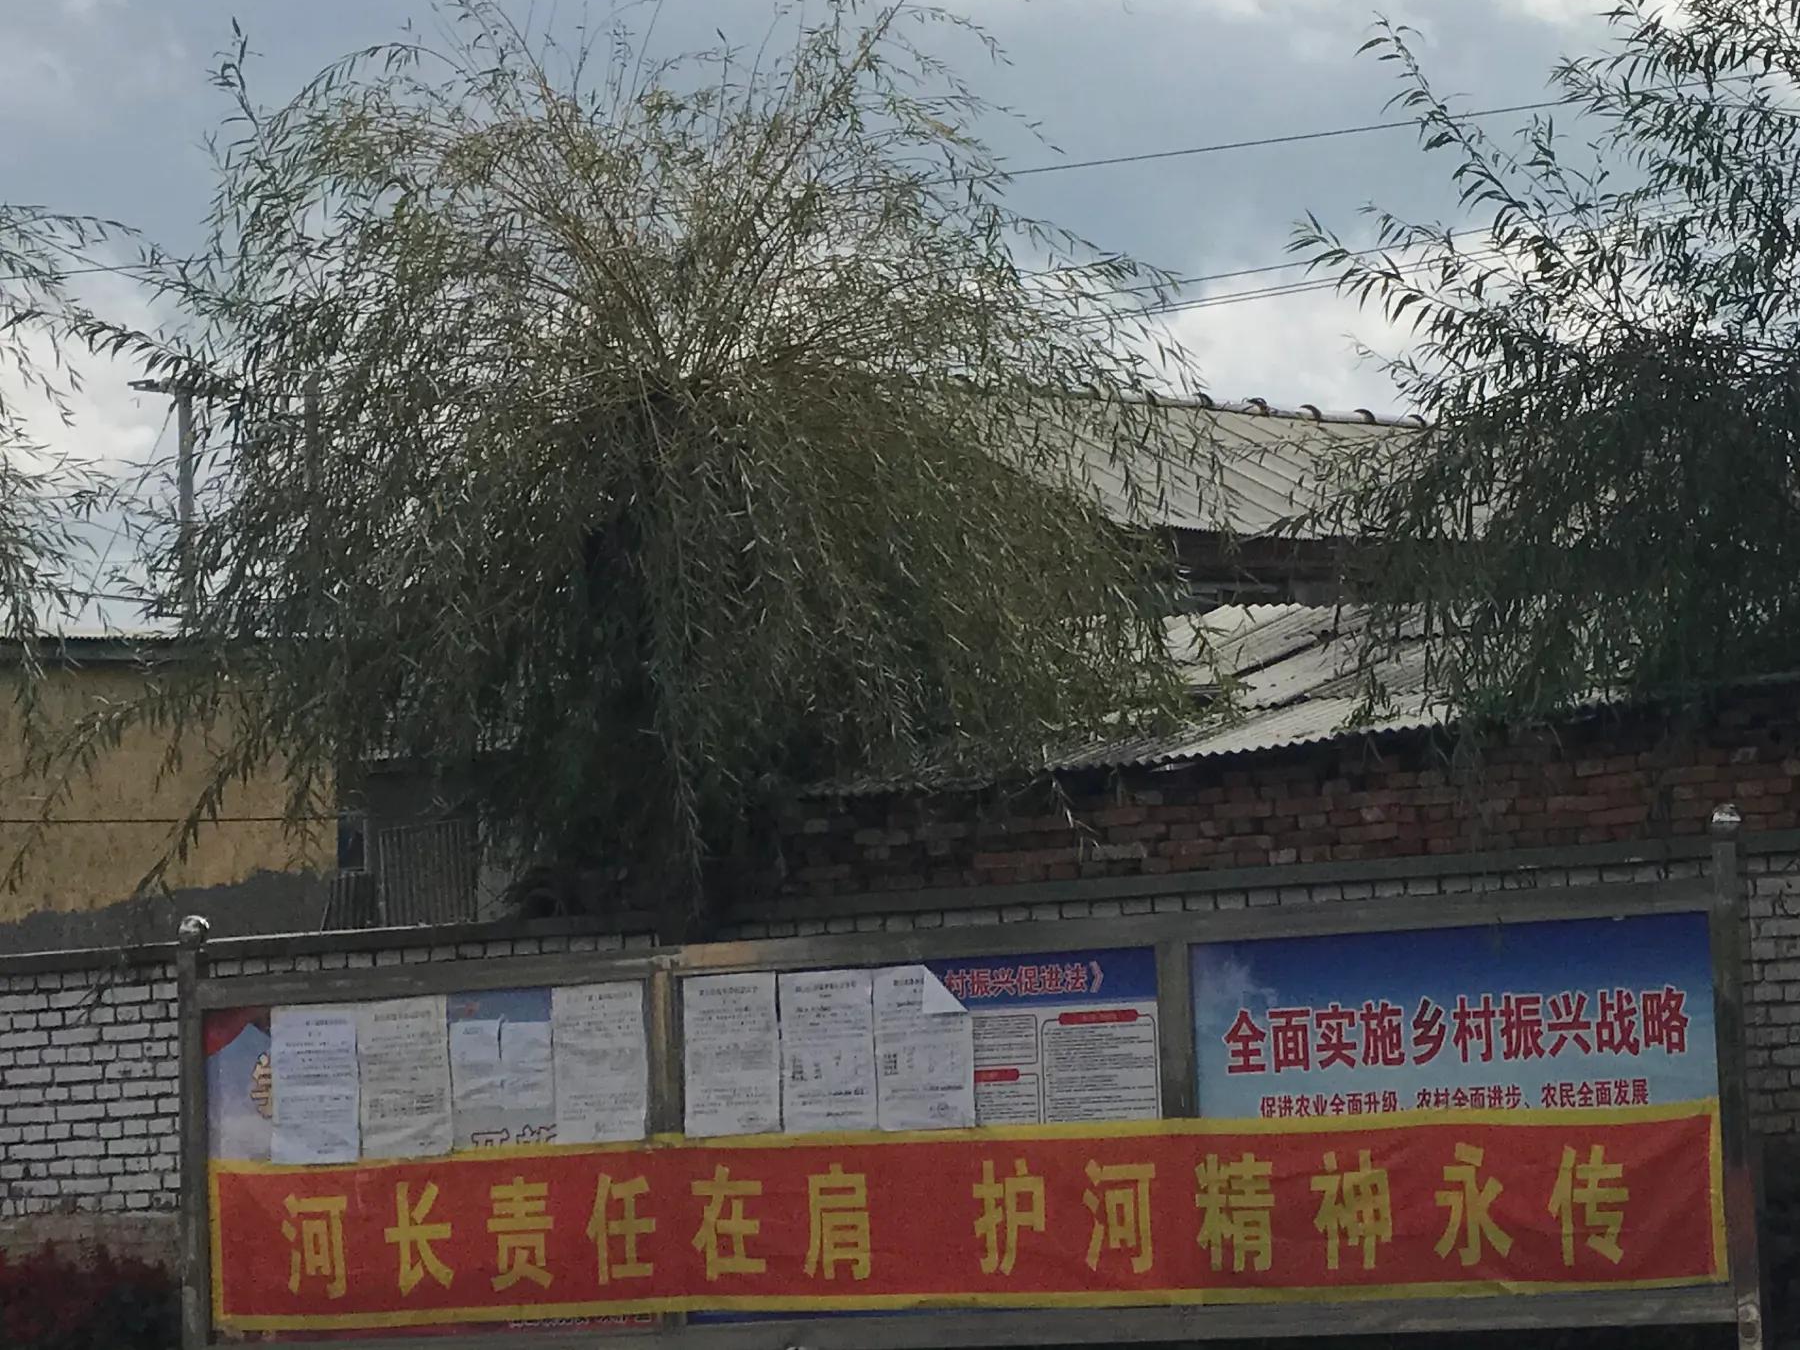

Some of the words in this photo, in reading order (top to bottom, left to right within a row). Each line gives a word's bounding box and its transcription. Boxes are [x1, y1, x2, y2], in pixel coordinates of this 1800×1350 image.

[938, 960, 1105, 1000] 村振兴促进法》
[1223, 984, 1690, 1075] 全面实施乡村振兴战略
[281, 1162, 872, 1300] 河长责任在肩
[972, 1142, 1631, 1278] 护河精神永传
